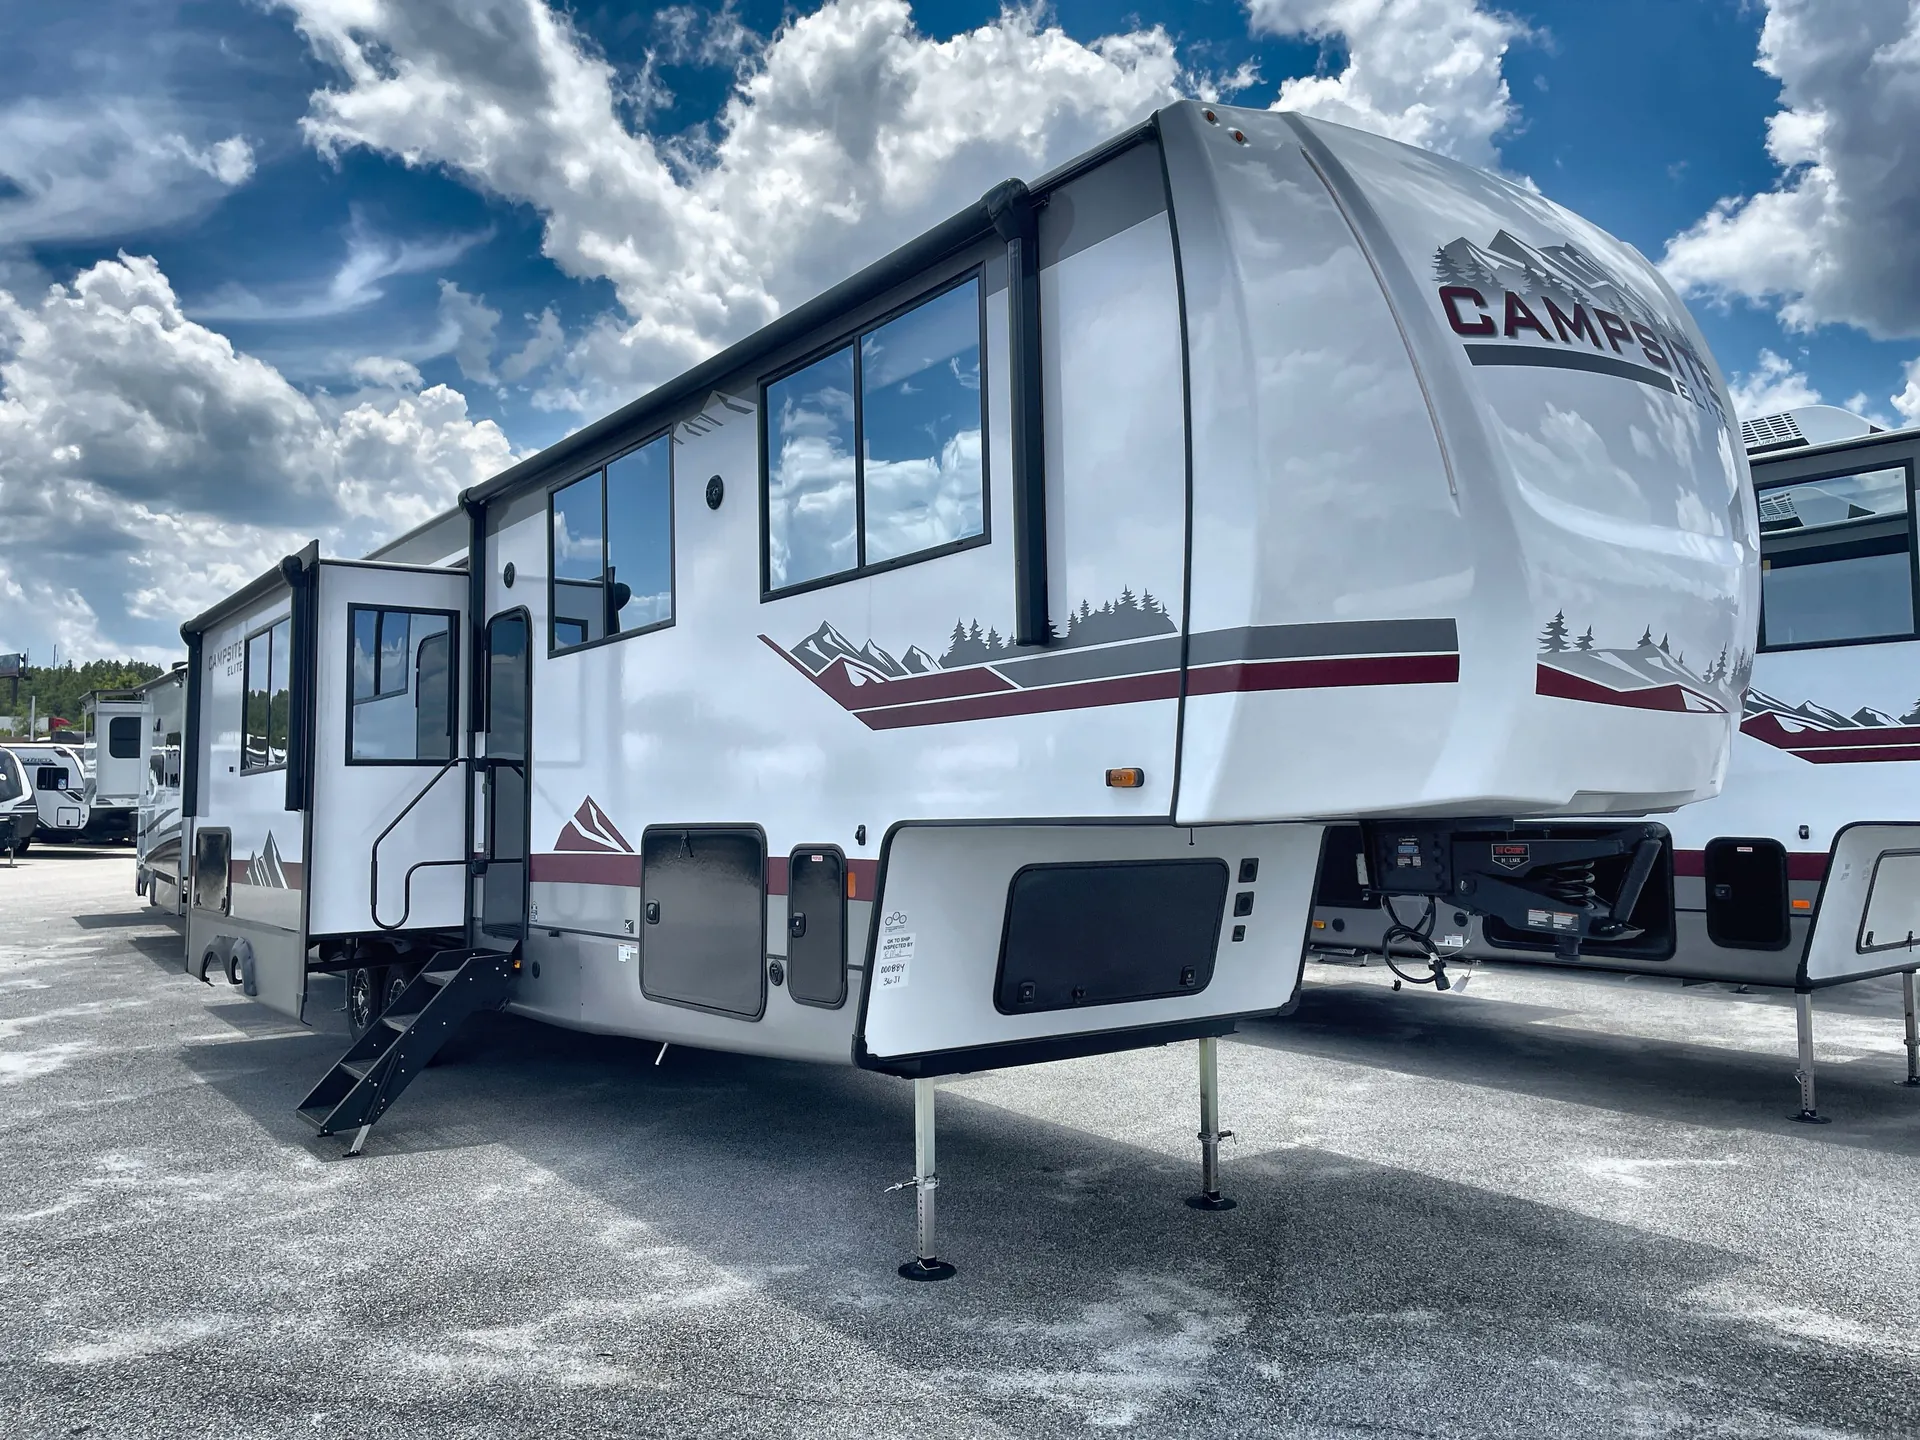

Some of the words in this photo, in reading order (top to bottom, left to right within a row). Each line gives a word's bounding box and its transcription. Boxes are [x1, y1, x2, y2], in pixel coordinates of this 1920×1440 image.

[1438, 285, 1724, 410] CAMPSITE
[1675, 379, 1731, 433] ELITE
[1753, 435, 1792, 446] FURRION
[208, 640, 243, 671] CAMPSITE
[227, 660, 243, 676] ELITE
